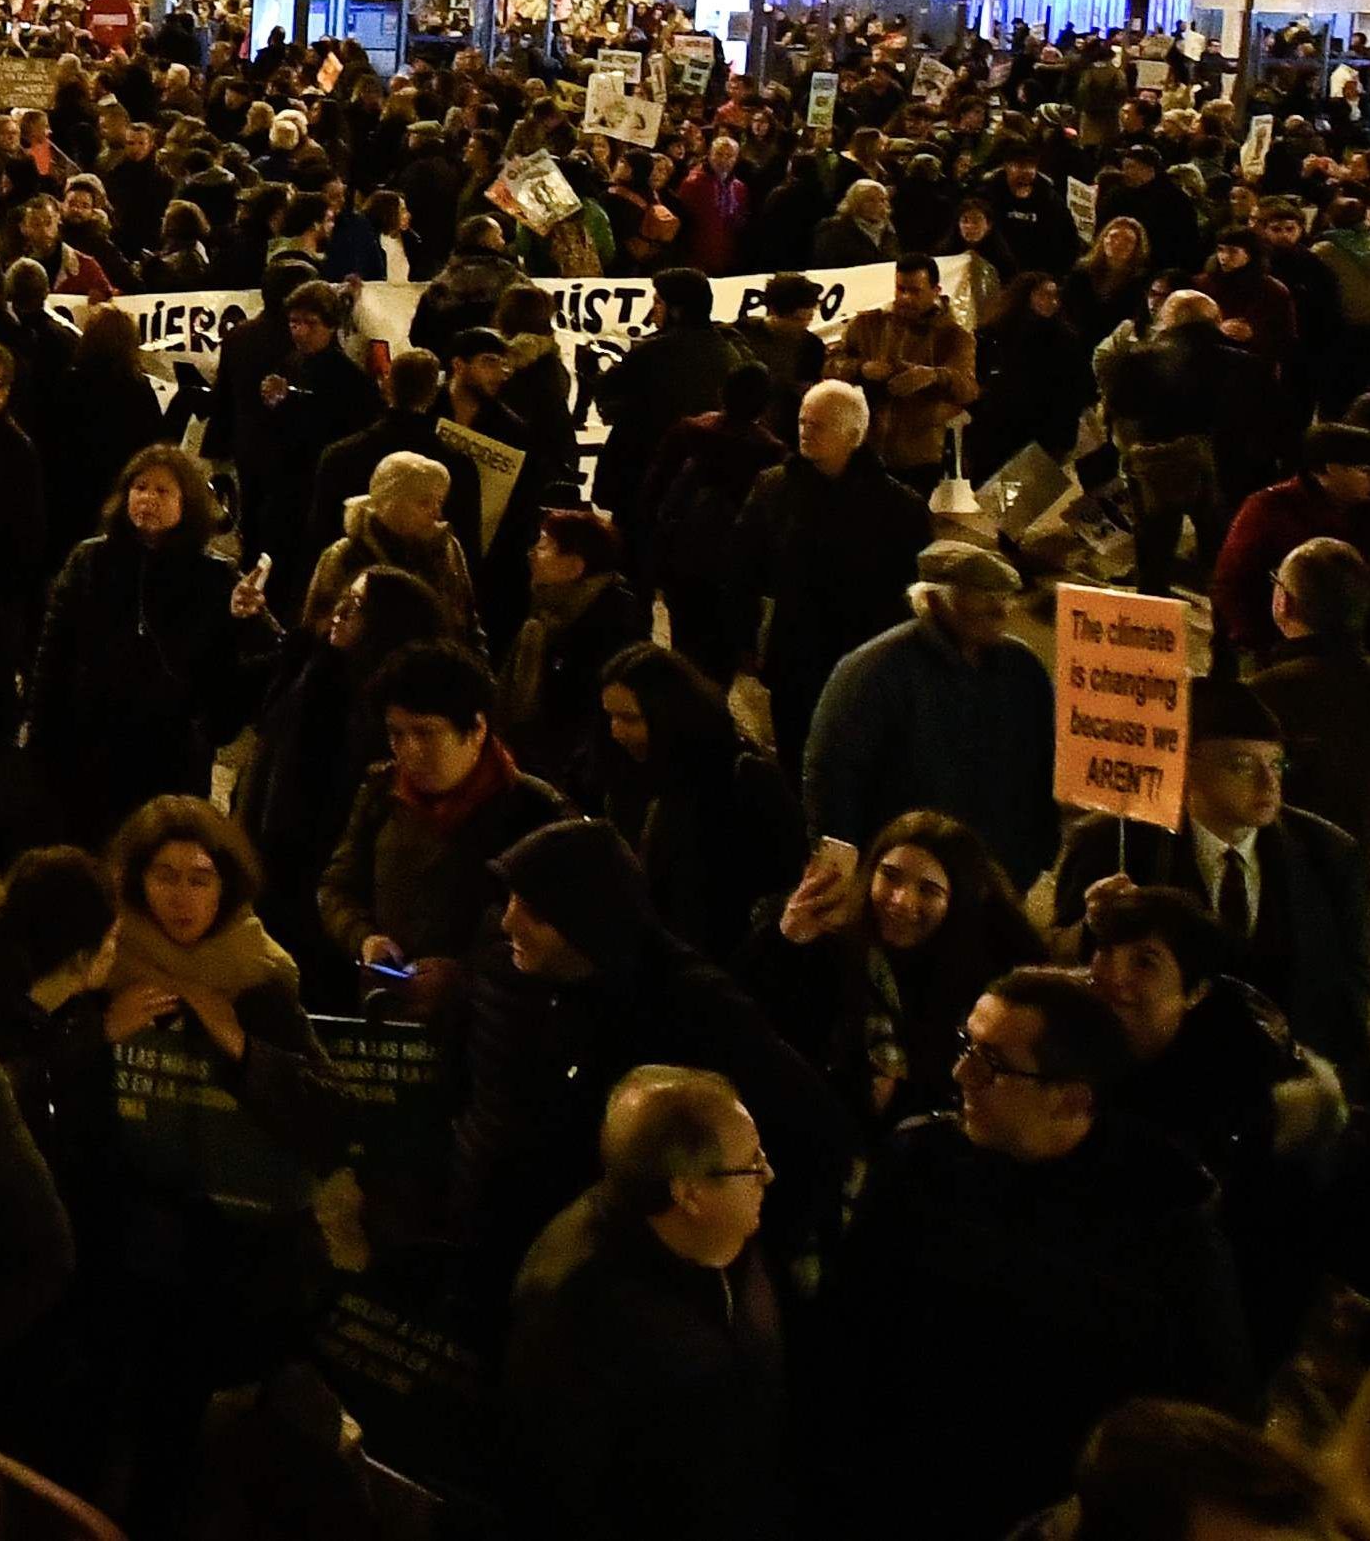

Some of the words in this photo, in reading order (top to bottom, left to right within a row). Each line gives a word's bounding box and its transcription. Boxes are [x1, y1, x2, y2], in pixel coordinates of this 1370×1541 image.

[1071, 609, 1103, 643] The
[1108, 609, 1177, 653] climate
[1070, 657, 1086, 689] is
[1090, 666, 1177, 712] changing
[1070, 705, 1147, 747] because
[1152, 726, 1178, 753] we
